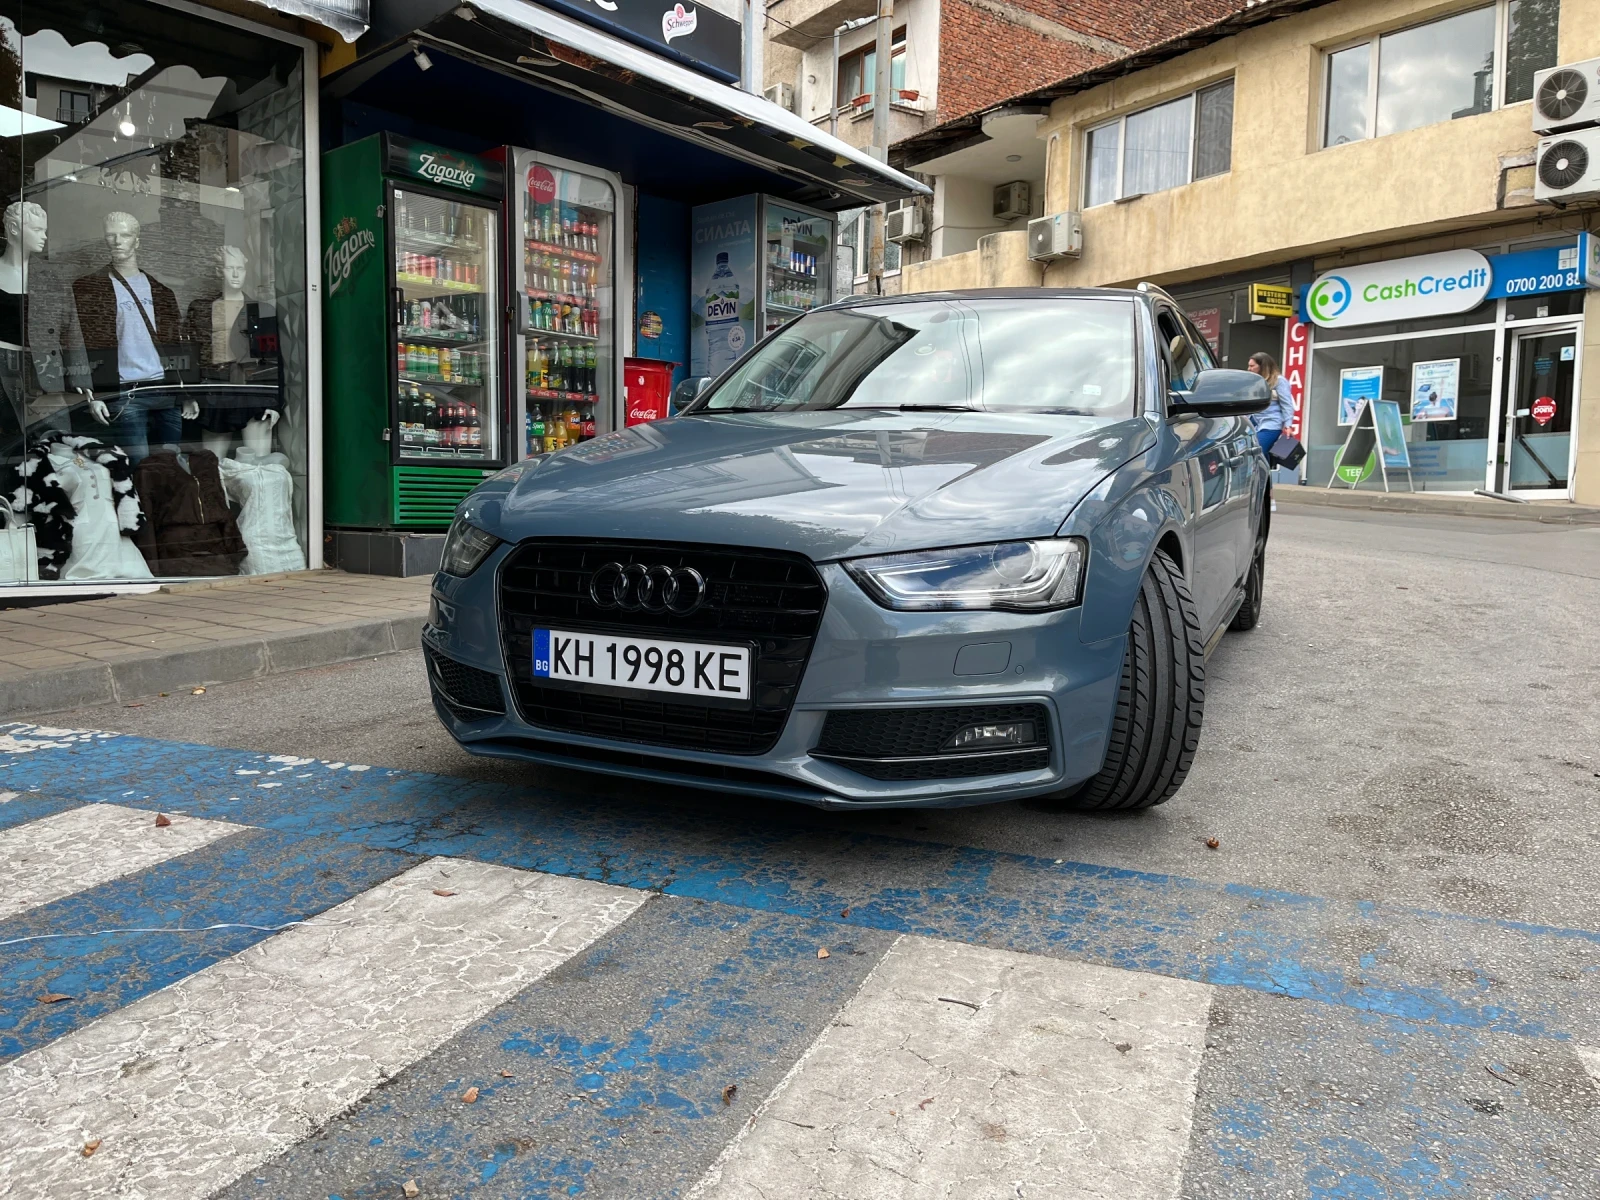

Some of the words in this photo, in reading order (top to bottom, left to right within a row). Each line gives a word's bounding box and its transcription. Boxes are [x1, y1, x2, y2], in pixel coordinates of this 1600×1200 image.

[417, 153, 476, 187] Zagorka
[527, 176, 555, 193] Coca-Cola
[695, 219, 752, 244] СИЛАТА
[782, 216, 813, 236] DEVIN
[323, 227, 375, 300] Zagorka
[1363, 268, 1487, 303] CashCredit
[1505, 275, 1536, 294] 0700
[1539, 273, 1563, 290] 200
[1257, 290, 1287, 299] WESTERN
[1266, 297, 1287, 305] UNION
[707, 301, 737, 317] DEVIN
[630, 407, 658, 420] Coca-Cola
[535, 659, 549, 671] BG
[554, 637, 595, 678] KH
[606, 642, 685, 687] 1998
[694, 650, 742, 693] KE
